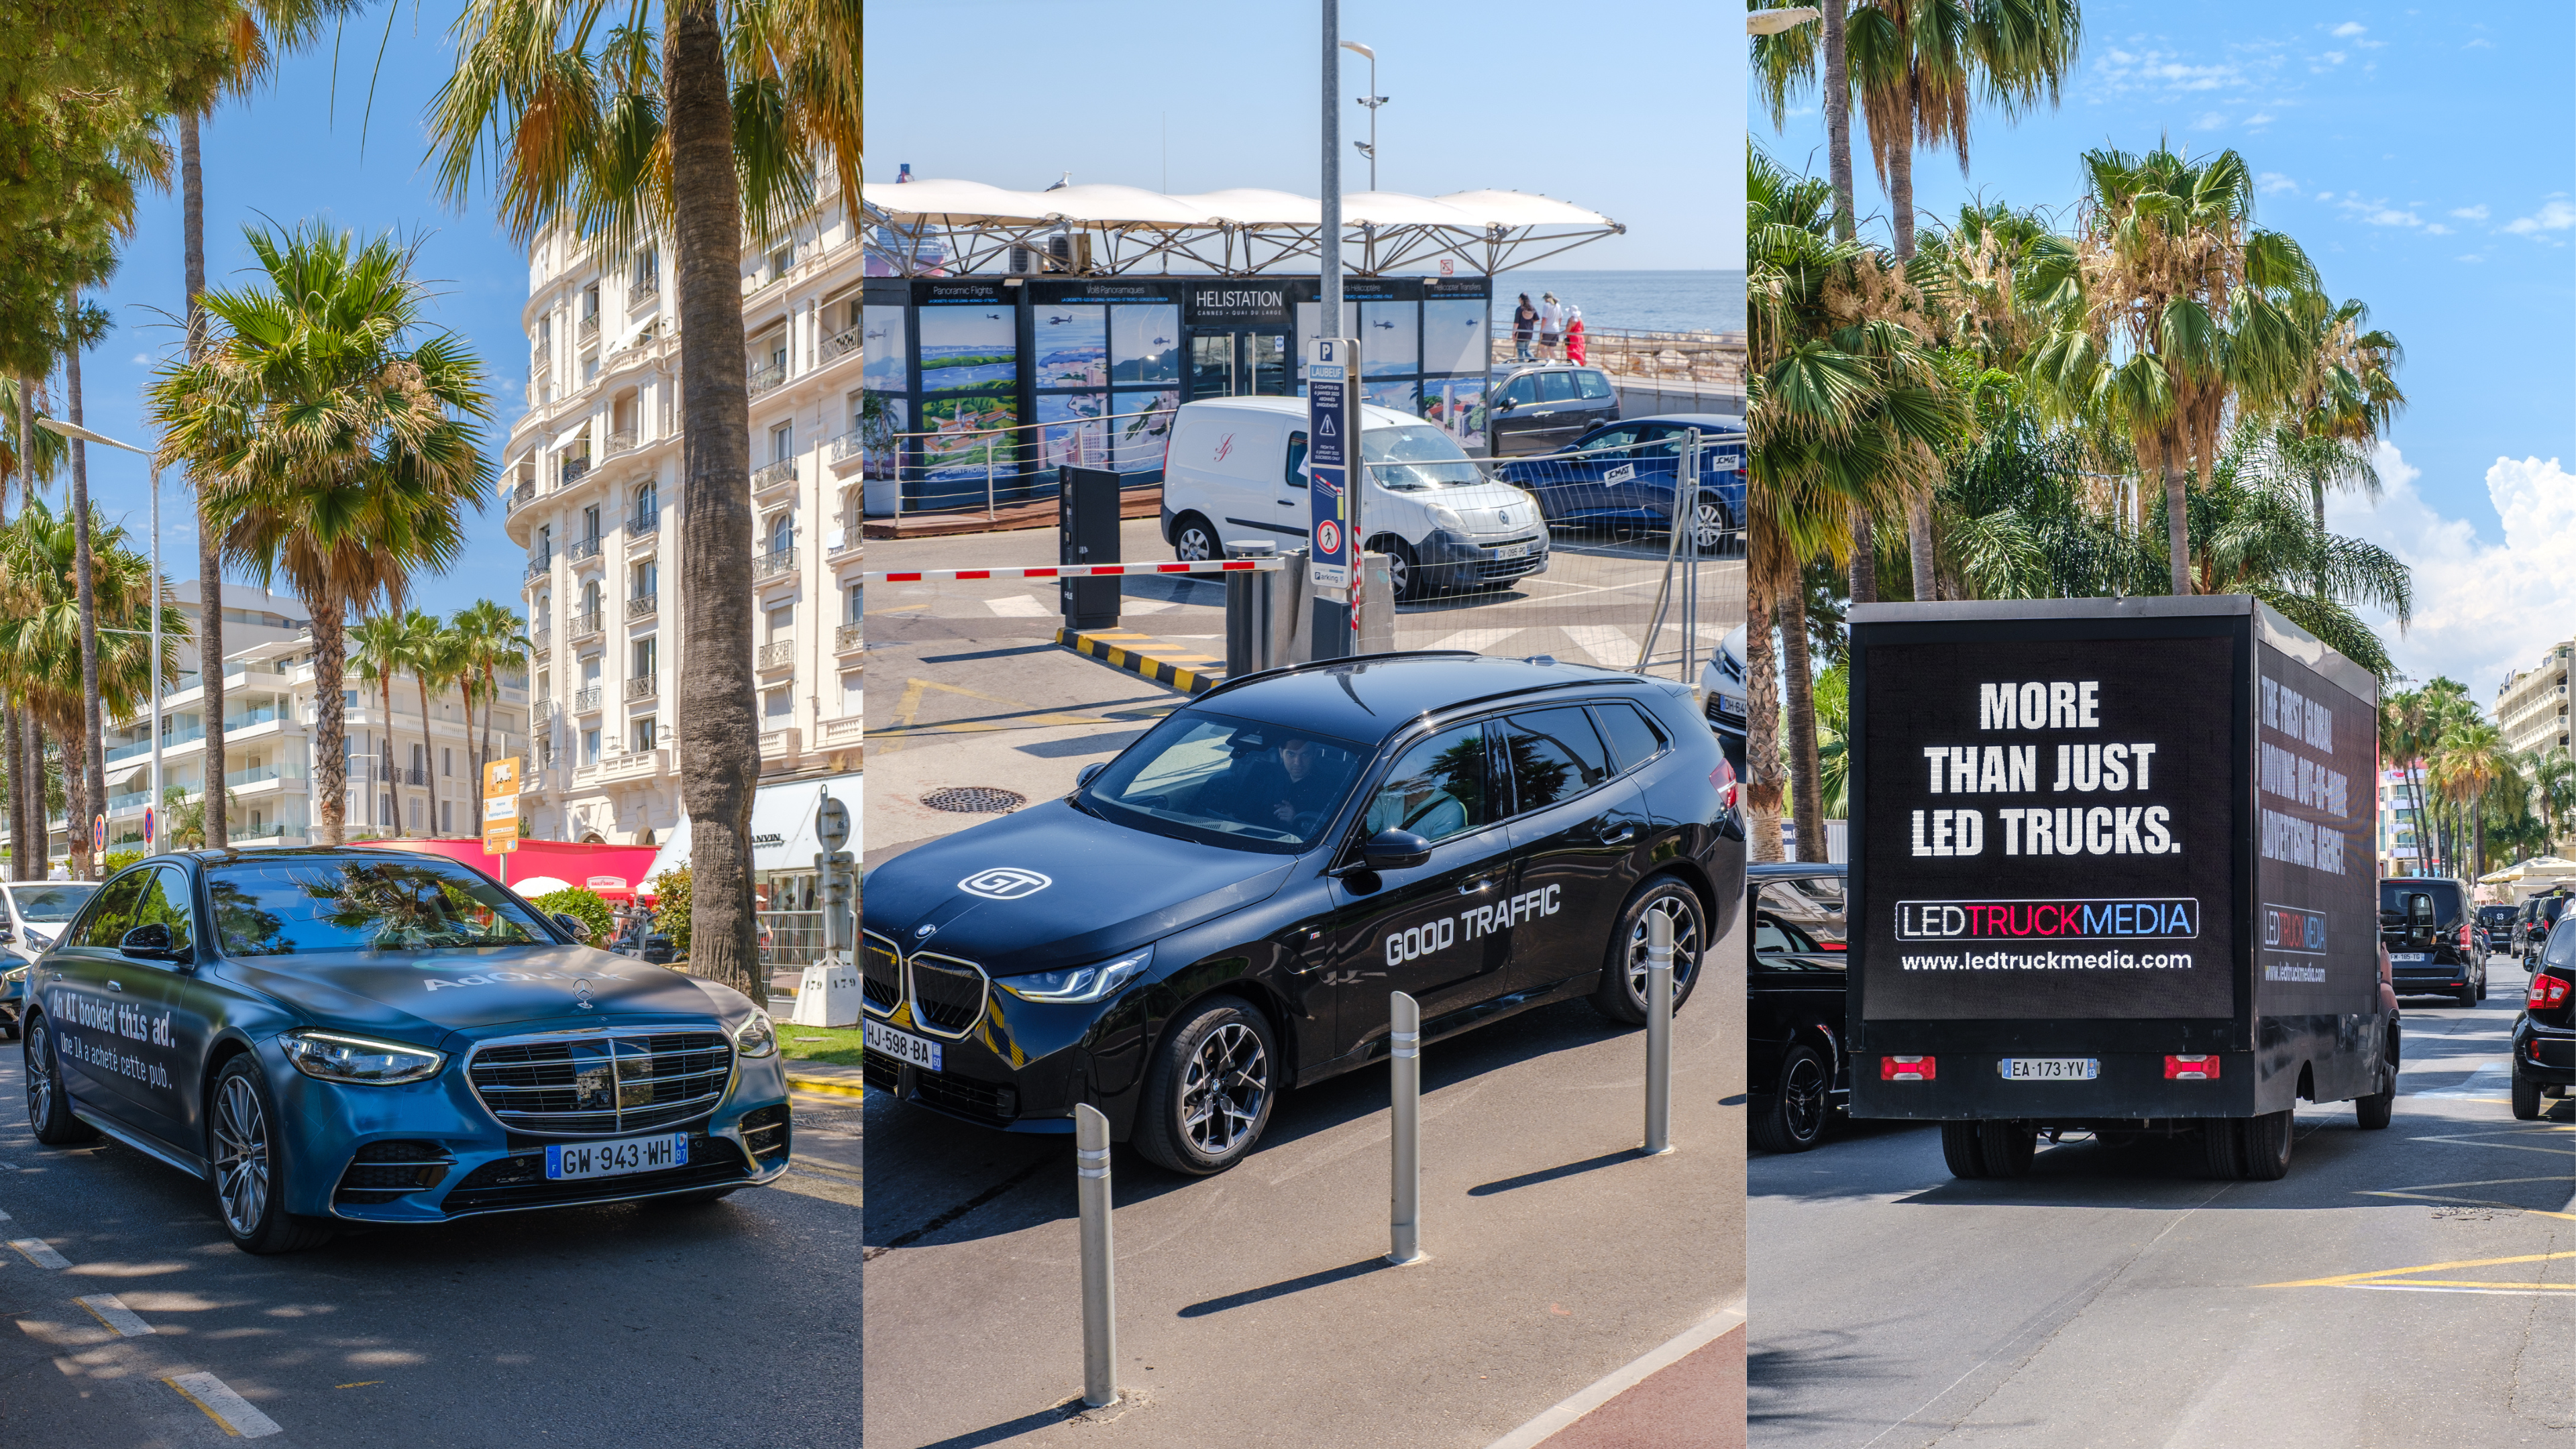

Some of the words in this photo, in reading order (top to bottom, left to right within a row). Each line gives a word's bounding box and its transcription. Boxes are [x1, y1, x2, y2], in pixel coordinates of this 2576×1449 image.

[933, 286, 970, 294] Panoramic
[971, 286, 993, 296] Flights
[1100, 286, 1144, 294] Panoramiques
[1434, 284, 1458, 292] Helicopter
[1196, 291, 1282, 307] HELISTATION
[1322, 343, 1330, 360] P
[1311, 367, 1342, 378] LAUBEUF
[865, 465, 885, 474] FREH
[1725, 699, 1746, 714] DH-64
[1980, 681, 2099, 730] MORE
[2261, 675, 2277, 730] THE
[2281, 684, 2303, 741] FIRST
[2305, 698, 2332, 755] GLOBAL
[1923, 745, 2036, 793] THAN
[2053, 743, 2156, 792] JUST
[2262, 741, 2296, 800] MOVING
[751, 833, 781, 843] ANVIN
[1912, 809, 1984, 857] LED
[1999, 806, 2181, 855] TRUCKS.
[2262, 808, 2314, 868] ADVERTISING
[1386, 917, 1454, 966] GOOD
[1461, 883, 1560, 941] TRAFFIC
[1901, 949, 2192, 970] www.ledtruckmedia.com
[423, 971, 635, 992] AdQuick
[2265, 961, 2326, 983] www.ledtruckmedia.com
[806, 980, 822, 989] 179
[53, 989, 64, 1019] An
[66, 992, 76, 1022] AI
[79, 995, 115, 1034] booked
[119, 1004, 147, 1041] this
[152, 1011, 175, 1048] ad.
[867, 1023, 928, 1064] HJ-598-BA
[60, 1032, 73, 1055] Une
[74, 1036, 83, 1059] IA
[85, 1044, 89, 1062] a
[91, 1044, 118, 1072] acheté
[121, 1055, 146, 1081] cette
[149, 1062, 172, 1089] pub.
[933, 1057, 941, 1067] 60
[2012, 1061, 2084, 1077] EA-173-YV
[564, 1139, 672, 1174] GW-943-WH
[676, 1148, 686, 1161] 87
